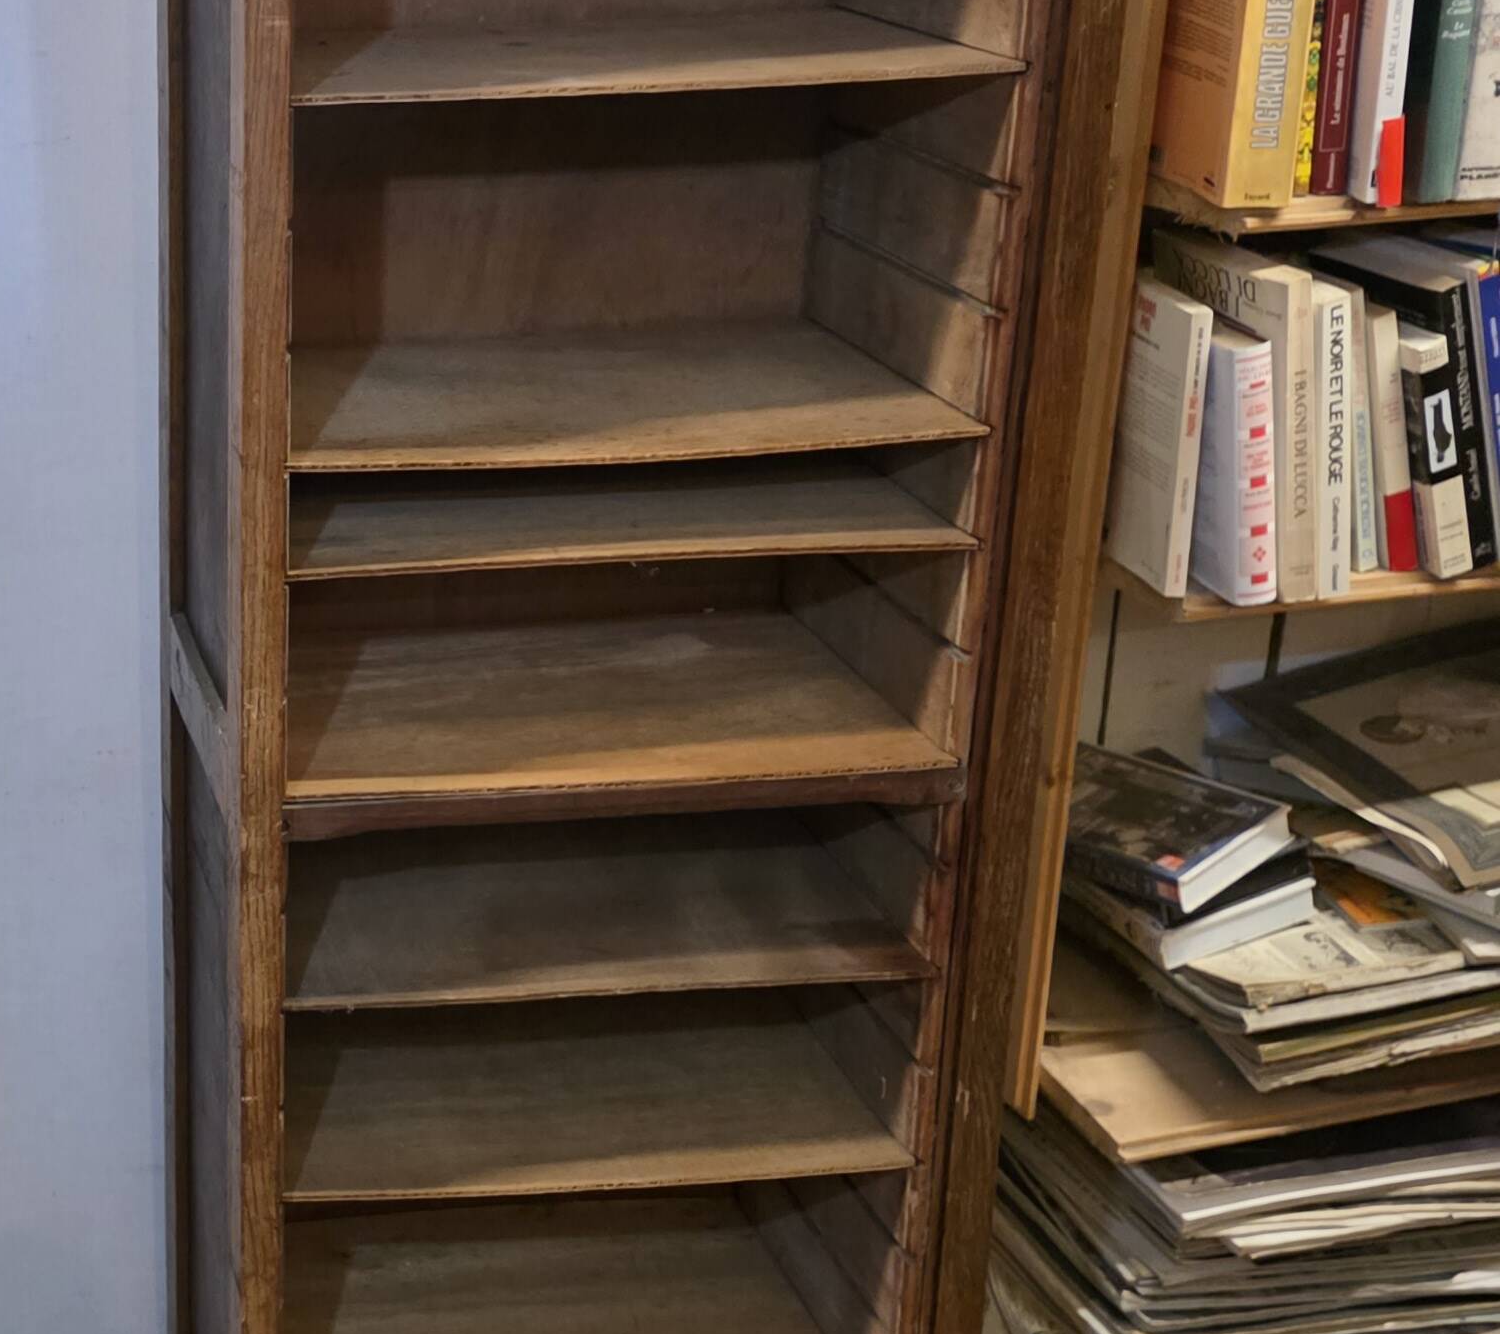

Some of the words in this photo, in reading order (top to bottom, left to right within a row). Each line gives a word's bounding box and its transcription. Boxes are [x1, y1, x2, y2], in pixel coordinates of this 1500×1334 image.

[1253, 42, 1289, 124] GRANDE
[1250, 125, 1278, 149] LA
[1330, 304, 1344, 329] LE
[1330, 330, 1344, 374] NOIR
[1329, 374, 1343, 397] ET
[1294, 380, 1308, 435] BAGNI
[1329, 400, 1344, 424] LE
[1294, 440, 1307, 459] DI
[1328, 425, 1344, 486] ROUGE
[1293, 463, 1308, 518] LUCCA
